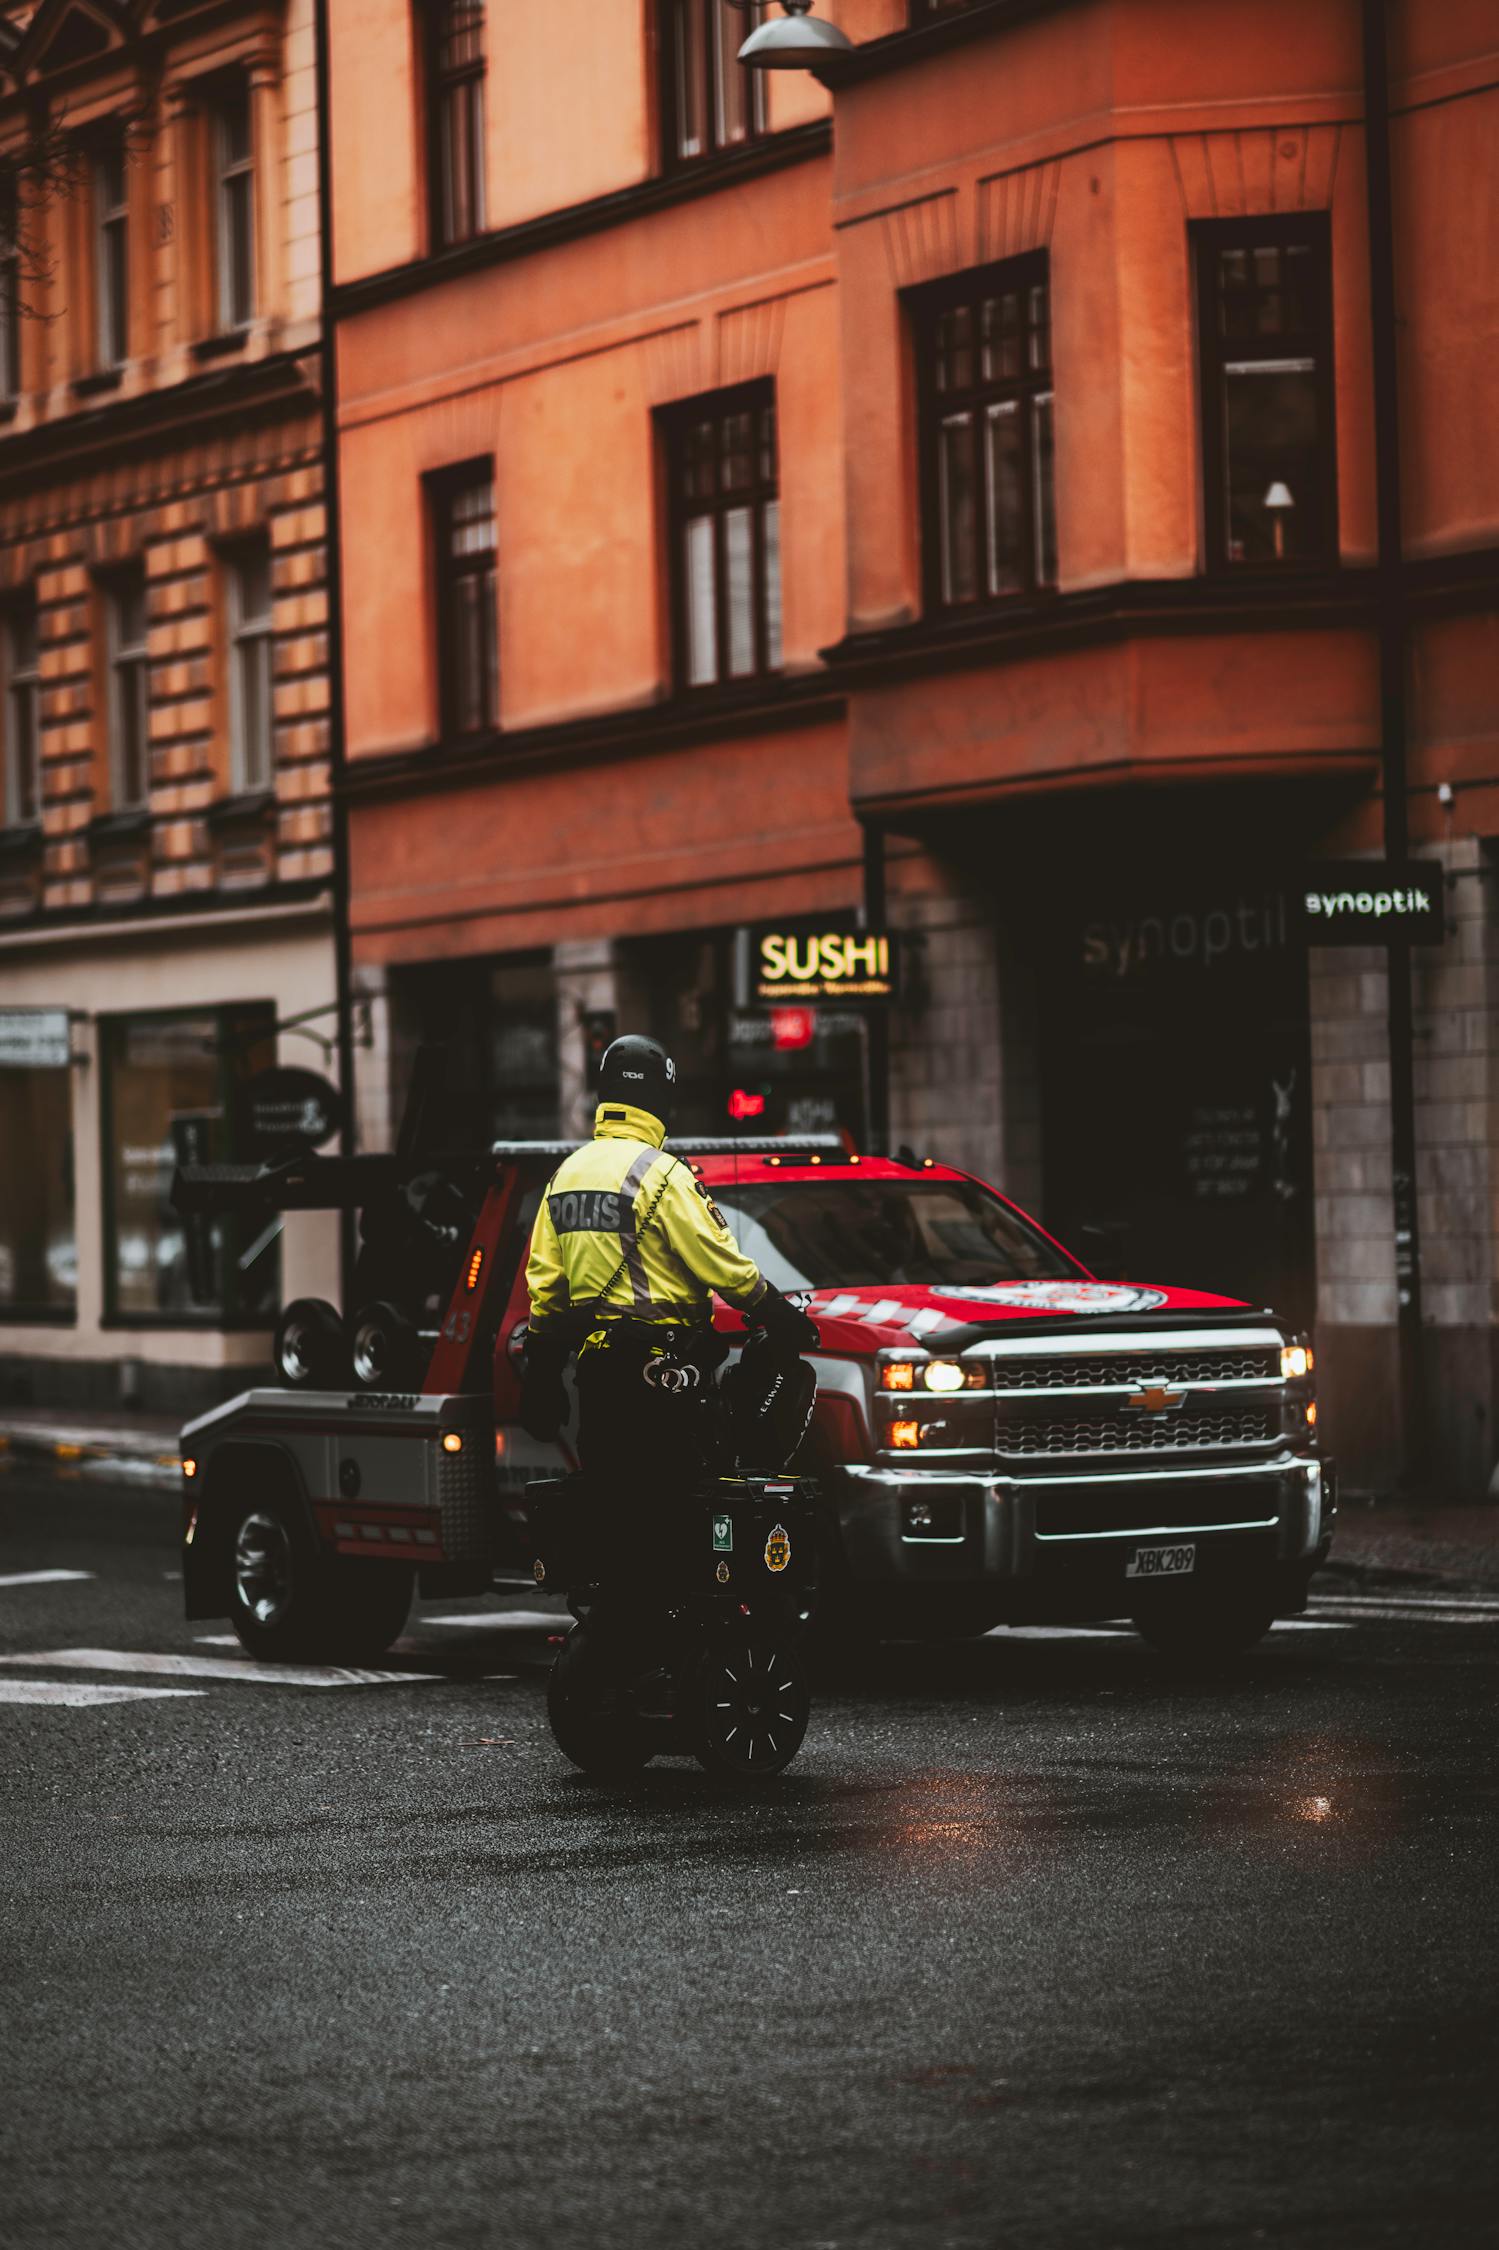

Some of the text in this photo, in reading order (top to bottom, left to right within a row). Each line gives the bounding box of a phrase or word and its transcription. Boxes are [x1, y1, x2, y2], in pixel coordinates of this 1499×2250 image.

[1304, 888, 1431, 919] synoptik
[760, 933, 890, 980] SUSHI
[548, 1193, 621, 1230] POLIS
[444, 1311, 472, 1345] 43
